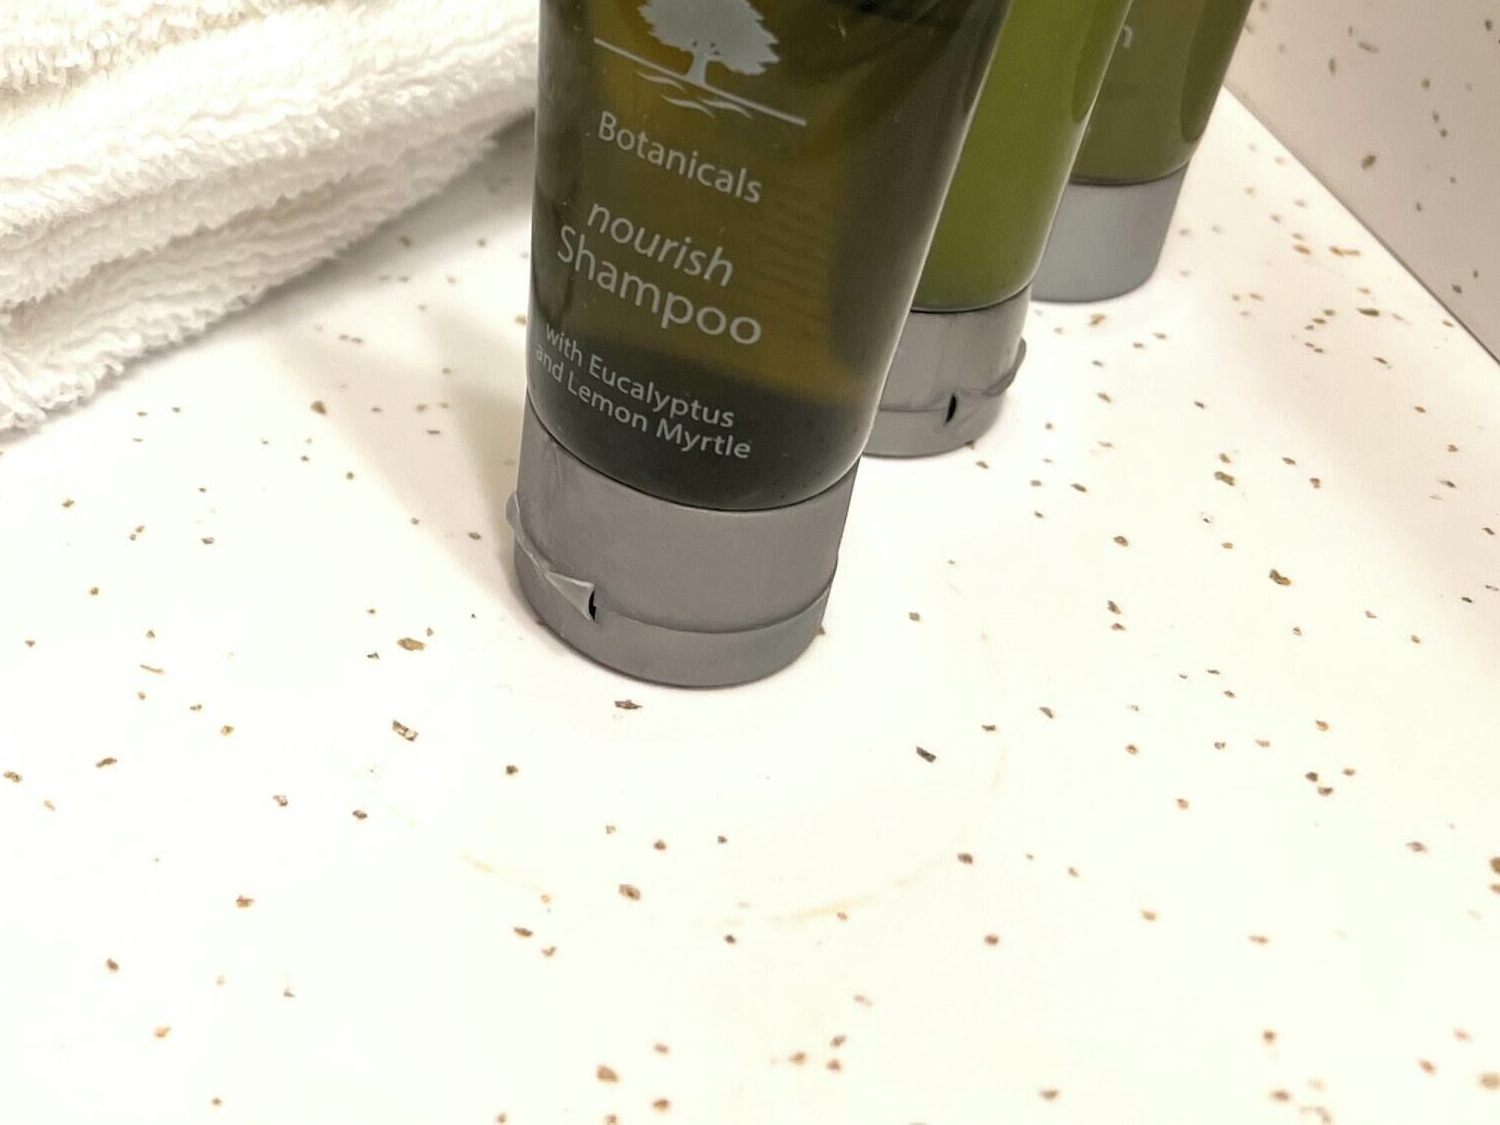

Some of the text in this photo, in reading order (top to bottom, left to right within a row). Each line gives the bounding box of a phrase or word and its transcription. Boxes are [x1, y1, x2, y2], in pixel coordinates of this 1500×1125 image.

[598, 110, 762, 204] Botanicals
[557, 224, 762, 345] Shampoo
[587, 202, 733, 287] nourish
[535, 343, 751, 459] and Lemon Myrtle
[545, 321, 735, 428] with Eucalyptus
